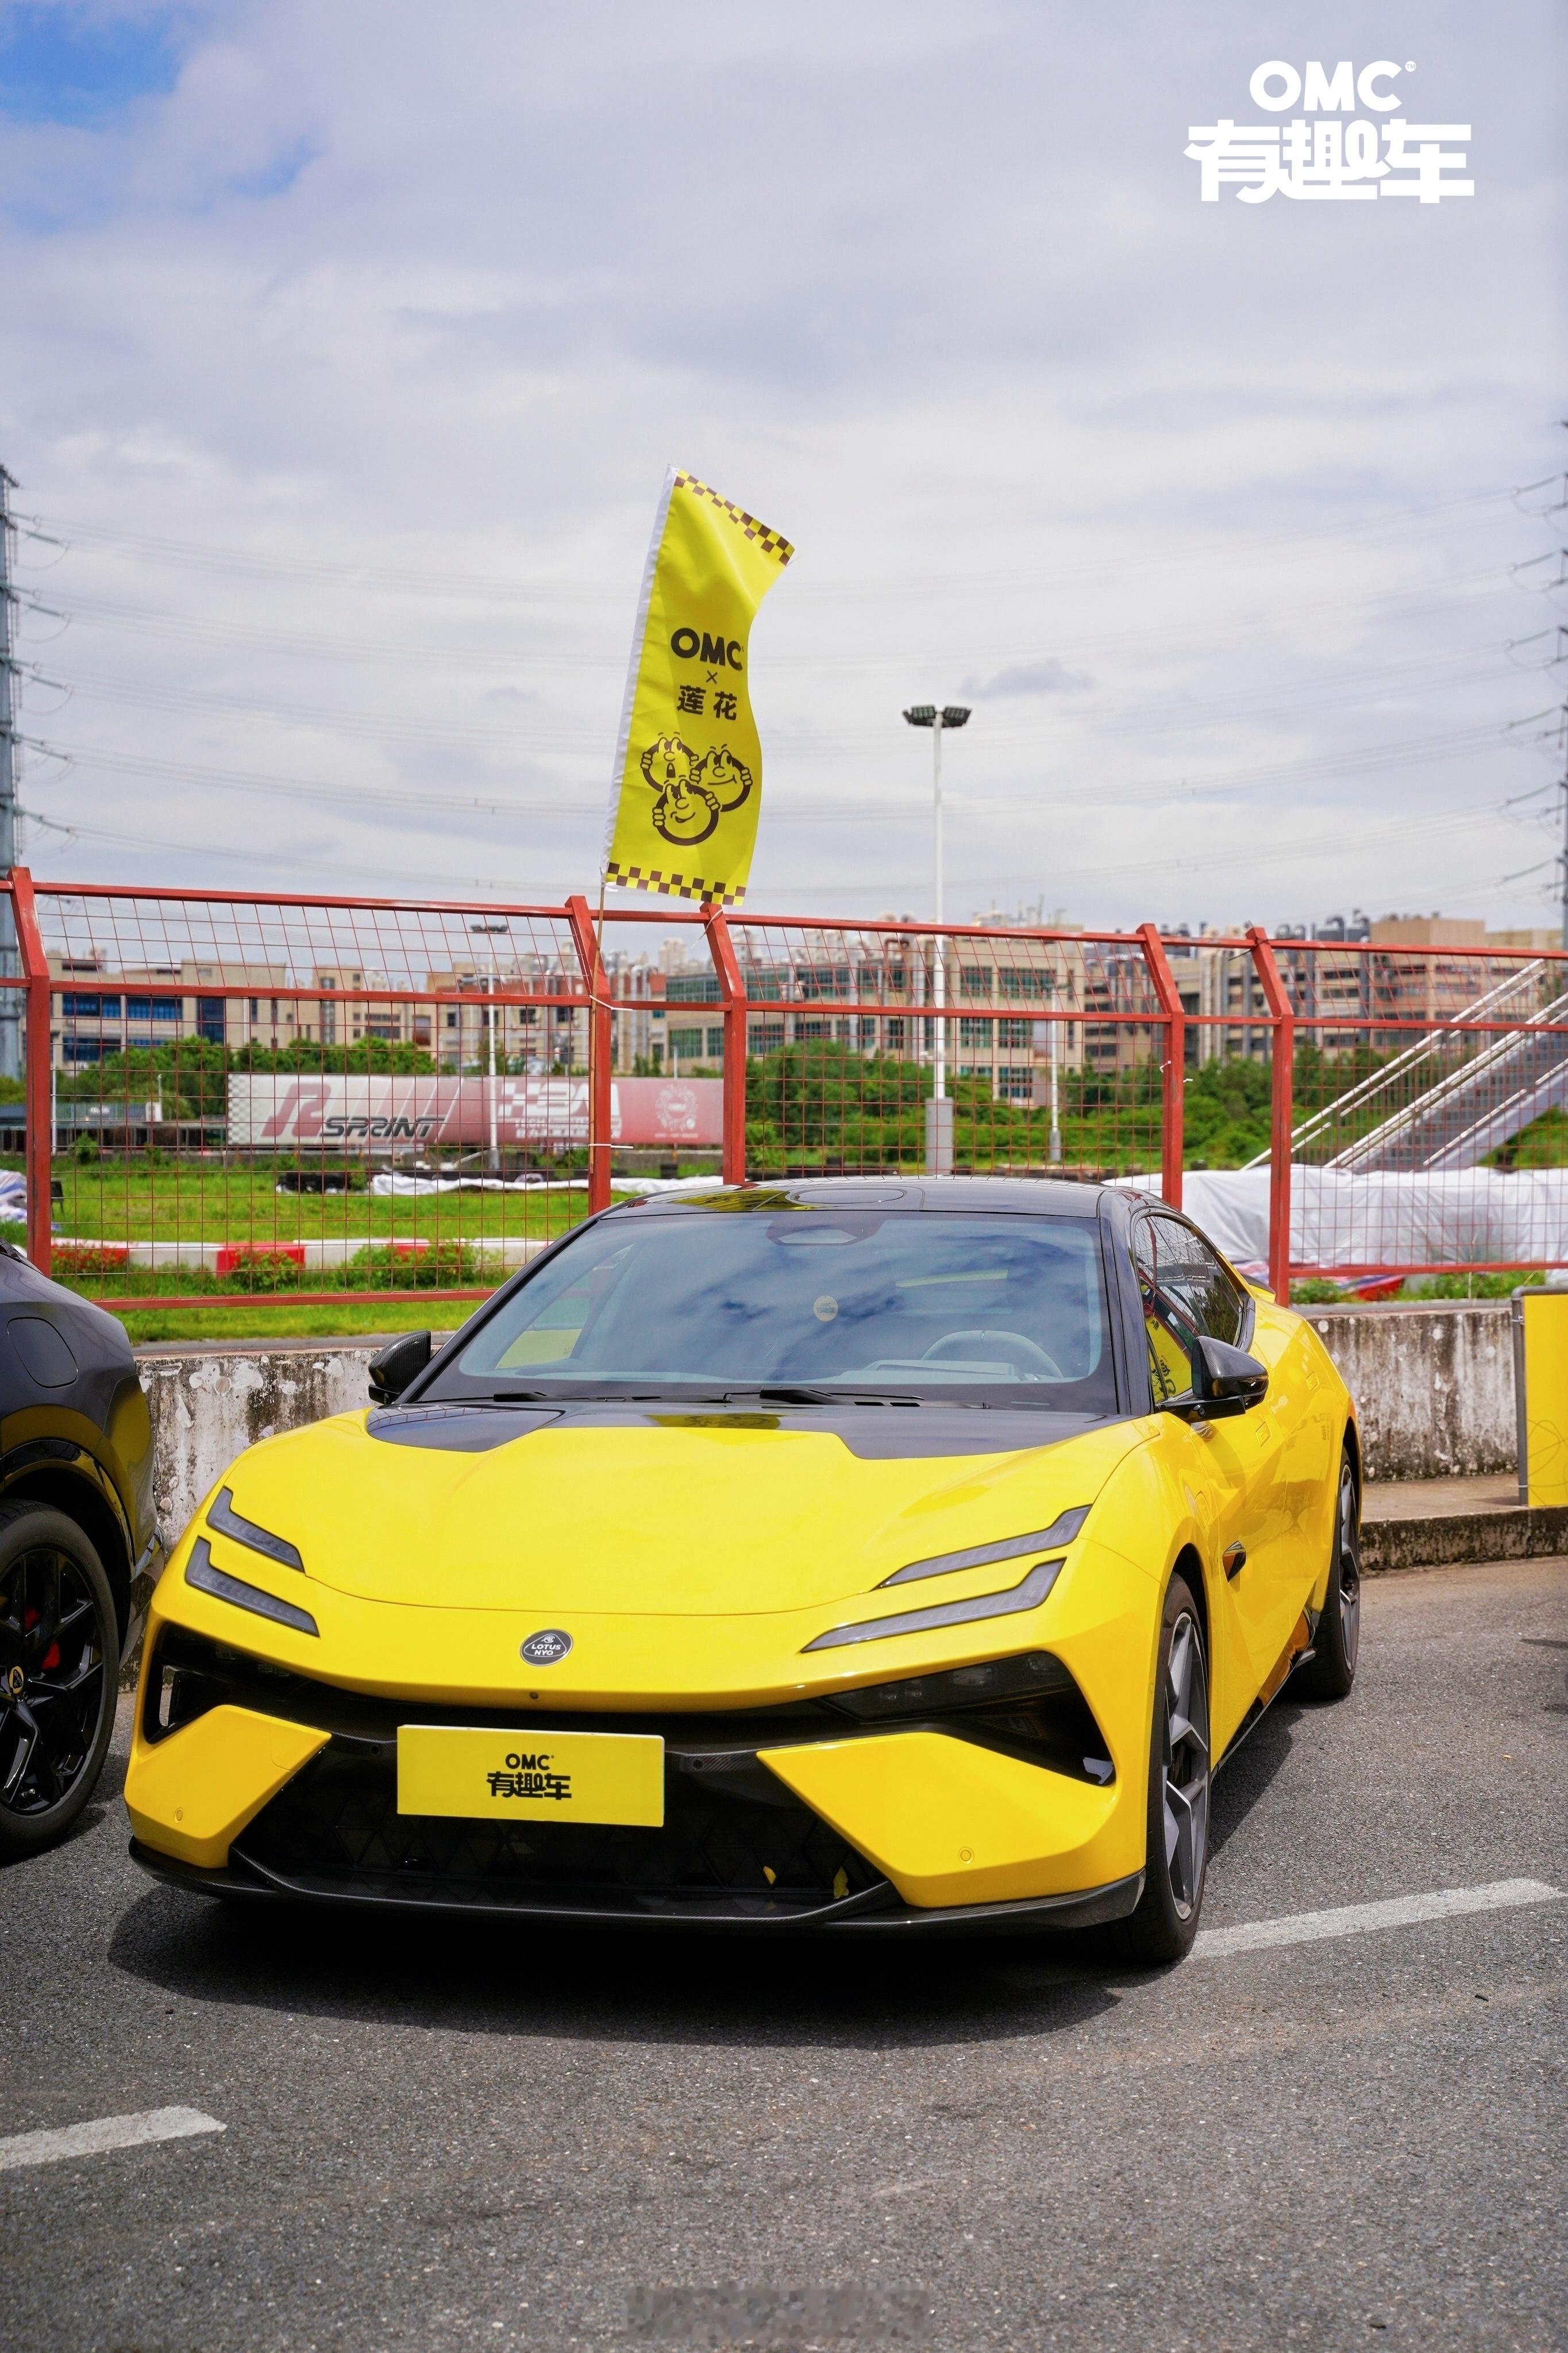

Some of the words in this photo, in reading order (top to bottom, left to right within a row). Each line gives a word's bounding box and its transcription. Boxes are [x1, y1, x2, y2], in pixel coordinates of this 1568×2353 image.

[671, 627, 743, 671] OMC
[676, 684, 737, 721] 莲花
[319, 1116, 446, 1137] SPRINT
[505, 1753, 550, 1771] OMC
[486, 1771, 572, 1801] 有趣车
